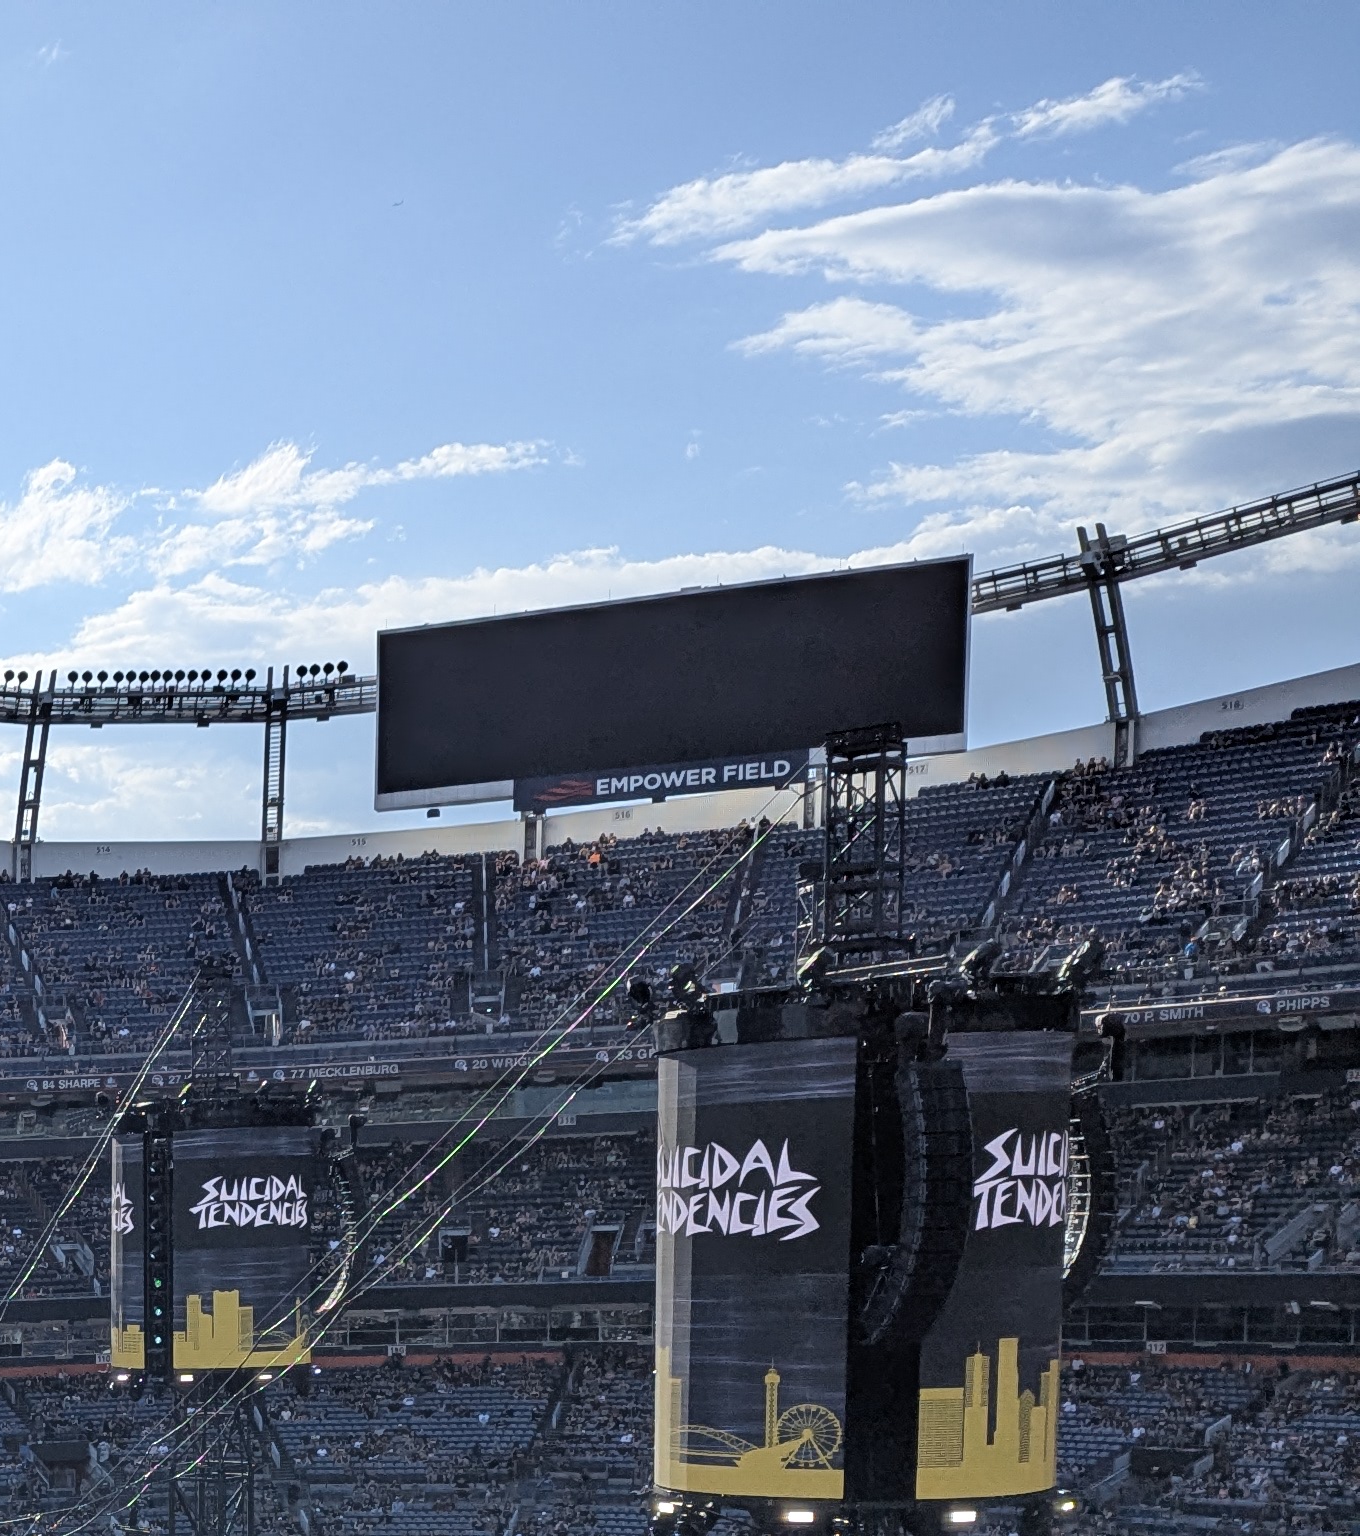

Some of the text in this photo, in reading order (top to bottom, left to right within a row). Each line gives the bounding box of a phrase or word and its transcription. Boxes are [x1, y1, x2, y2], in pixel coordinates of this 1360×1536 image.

[595, 766, 717, 796] EMPOWER
[723, 760, 791, 783] FIELD
[1277, 996, 1330, 1012] PHIPPS
[1124, 1012, 1140, 1023] 70
[1160, 1006, 1204, 1021] SMITH
[291, 1064, 399, 1079] 77 MECKLENBURG
[472, 1057, 543, 1070] 20 WRIG
[42, 1079, 100, 1090] 84 SHARPE
[169, 1075, 181, 1085] 27
[196, 1174, 308, 1206] SUICIDAL
[188, 1200, 308, 1230] TENDENCIES
